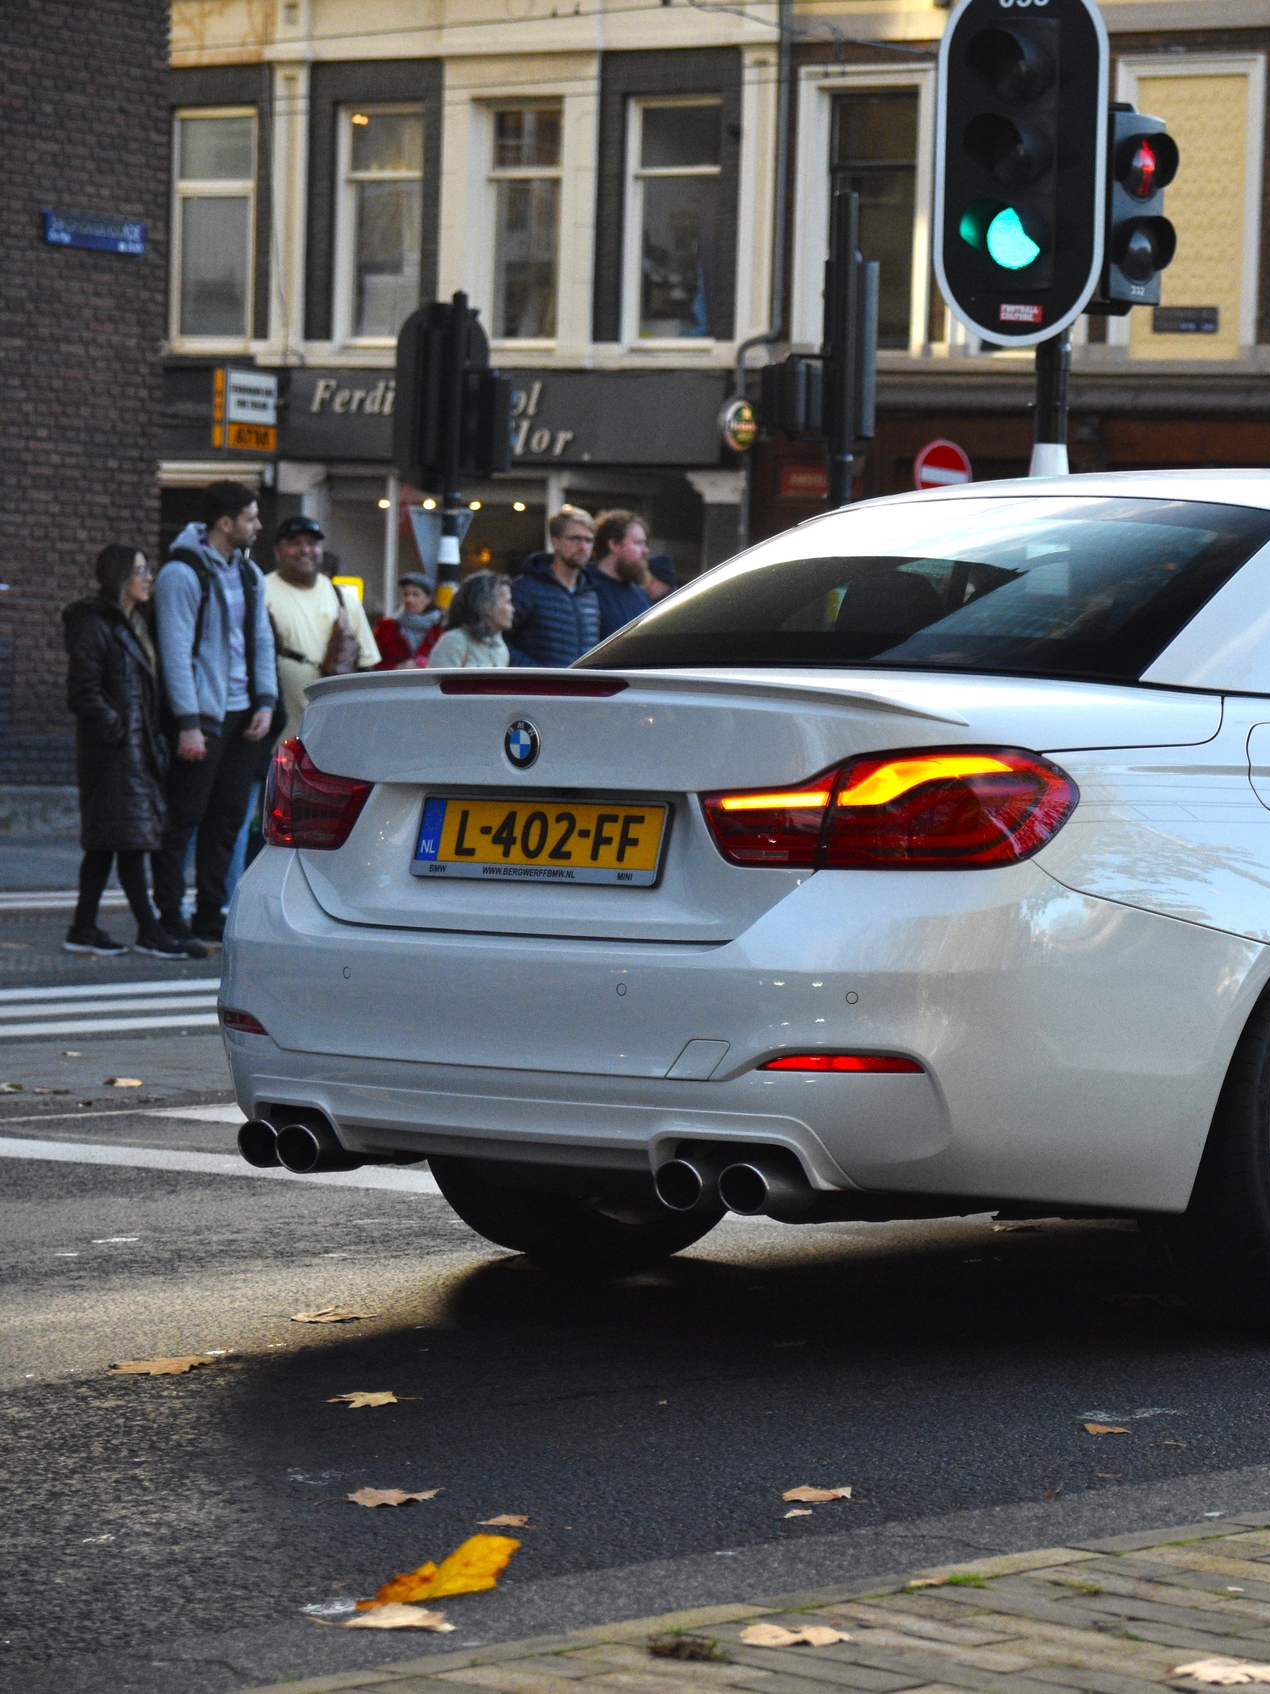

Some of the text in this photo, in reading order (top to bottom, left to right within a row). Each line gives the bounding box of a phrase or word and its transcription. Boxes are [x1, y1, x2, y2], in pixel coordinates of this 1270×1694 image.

[310, 378, 542, 416] Ferdi ol
[508, 721, 536, 737] BMW
[454, 810, 645, 863] L-402-FF
[420, 839, 436, 854] NL
[428, 864, 633, 881] BMW WWW.BERGWERFFBMW.NL MINI
